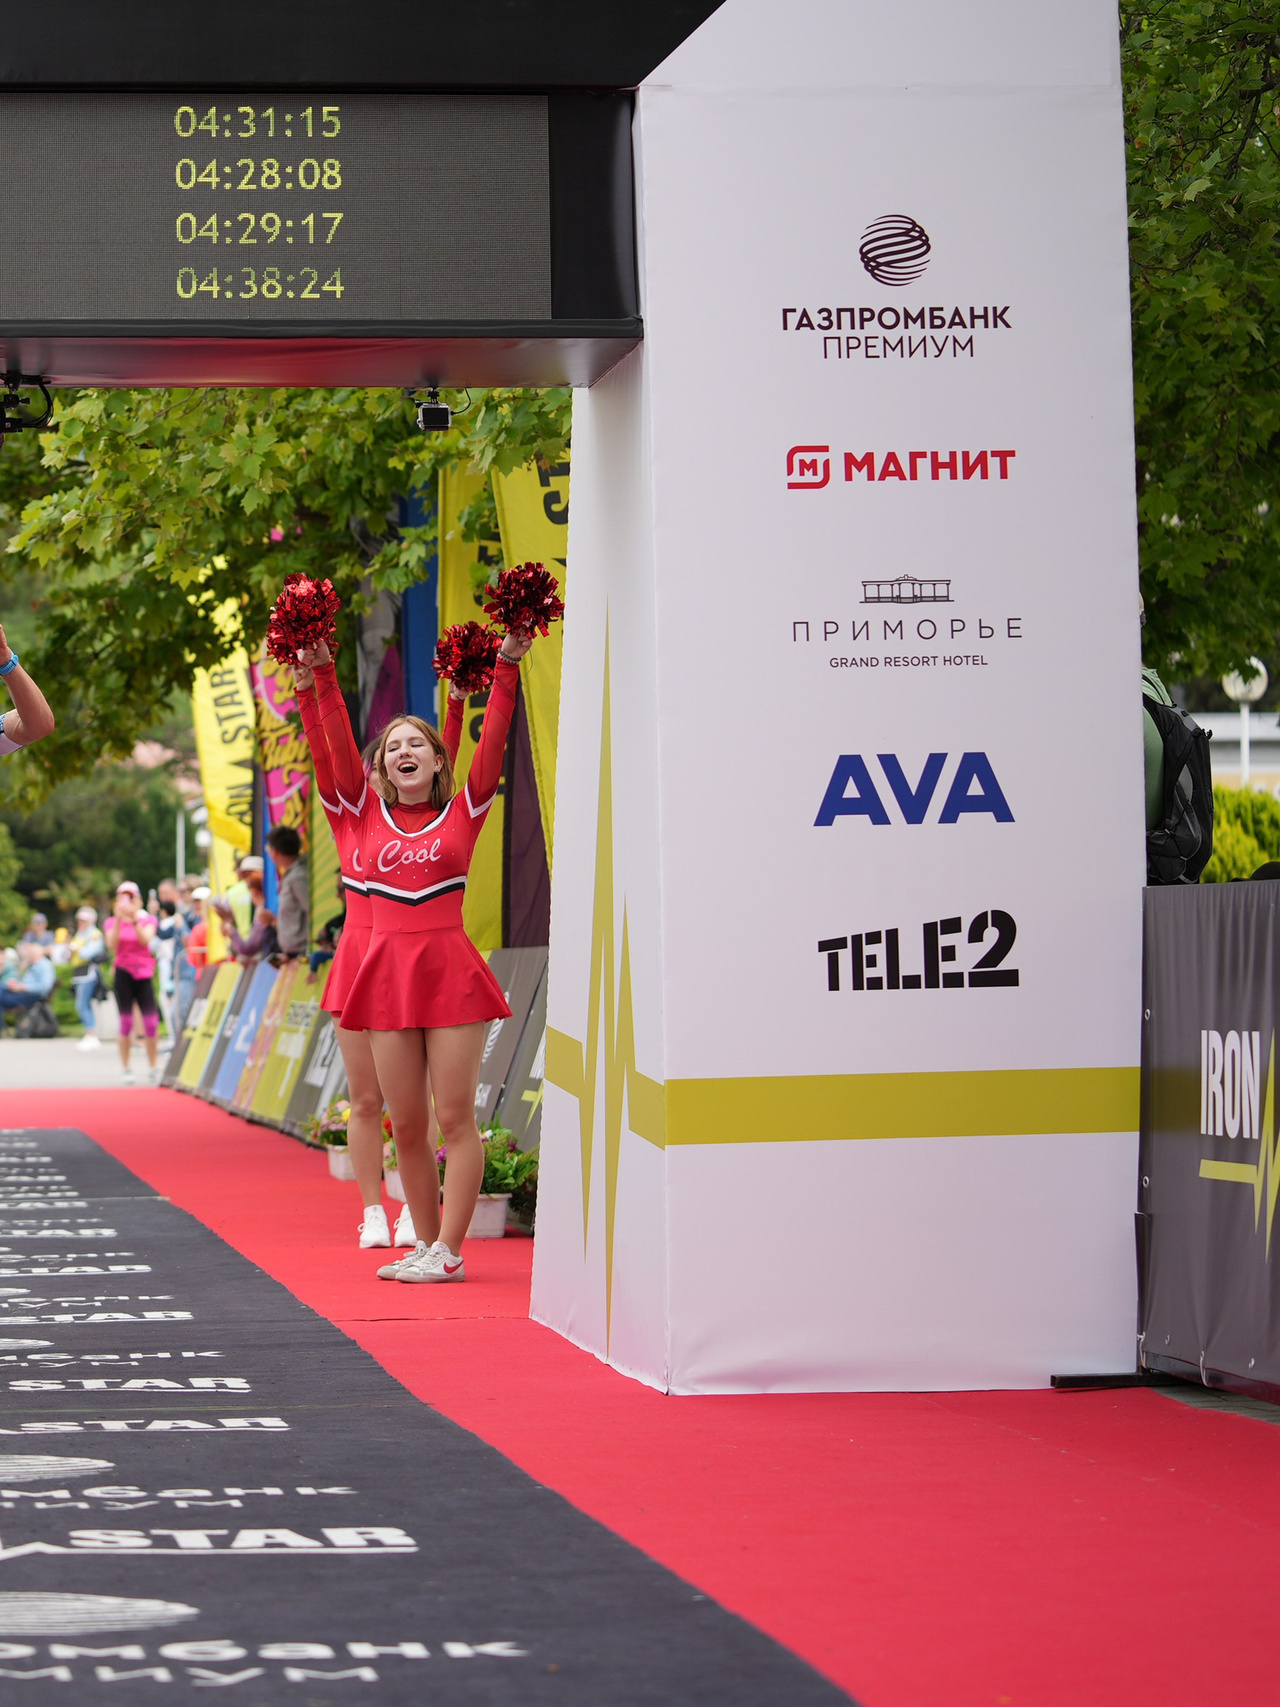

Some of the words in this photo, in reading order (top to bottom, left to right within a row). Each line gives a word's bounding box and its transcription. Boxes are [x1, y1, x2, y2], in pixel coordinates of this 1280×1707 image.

[173, 105, 342, 138] 04:31:15
[175, 158, 343, 190] 04:28:08
[175, 212, 344, 244] 04:29:17
[176, 267, 345, 299] 04:38:24
[781, 305, 1013, 332] ГАЗПРОМБАНК
[822, 334, 975, 360] ПРЕМИУМ
[843, 449, 1017, 482] МАГНИТ
[792, 617, 1023, 643] ПРИМОРЬЕ
[829, 656, 880, 669] GRAND
[883, 655, 939, 668] RESORT
[942, 654, 989, 667] HOTEL
[210, 668, 253, 744] STAR
[813, 752, 1016, 826] AVA
[377, 838, 441, 873] Cool
[817, 909, 1020, 992] TELE2
[1200, 1029, 1261, 1140] IRON
[9, 1376, 251, 1391] STAR
[19, 1416, 290, 1431] STAR
[68, 1526, 418, 1549] STAR
